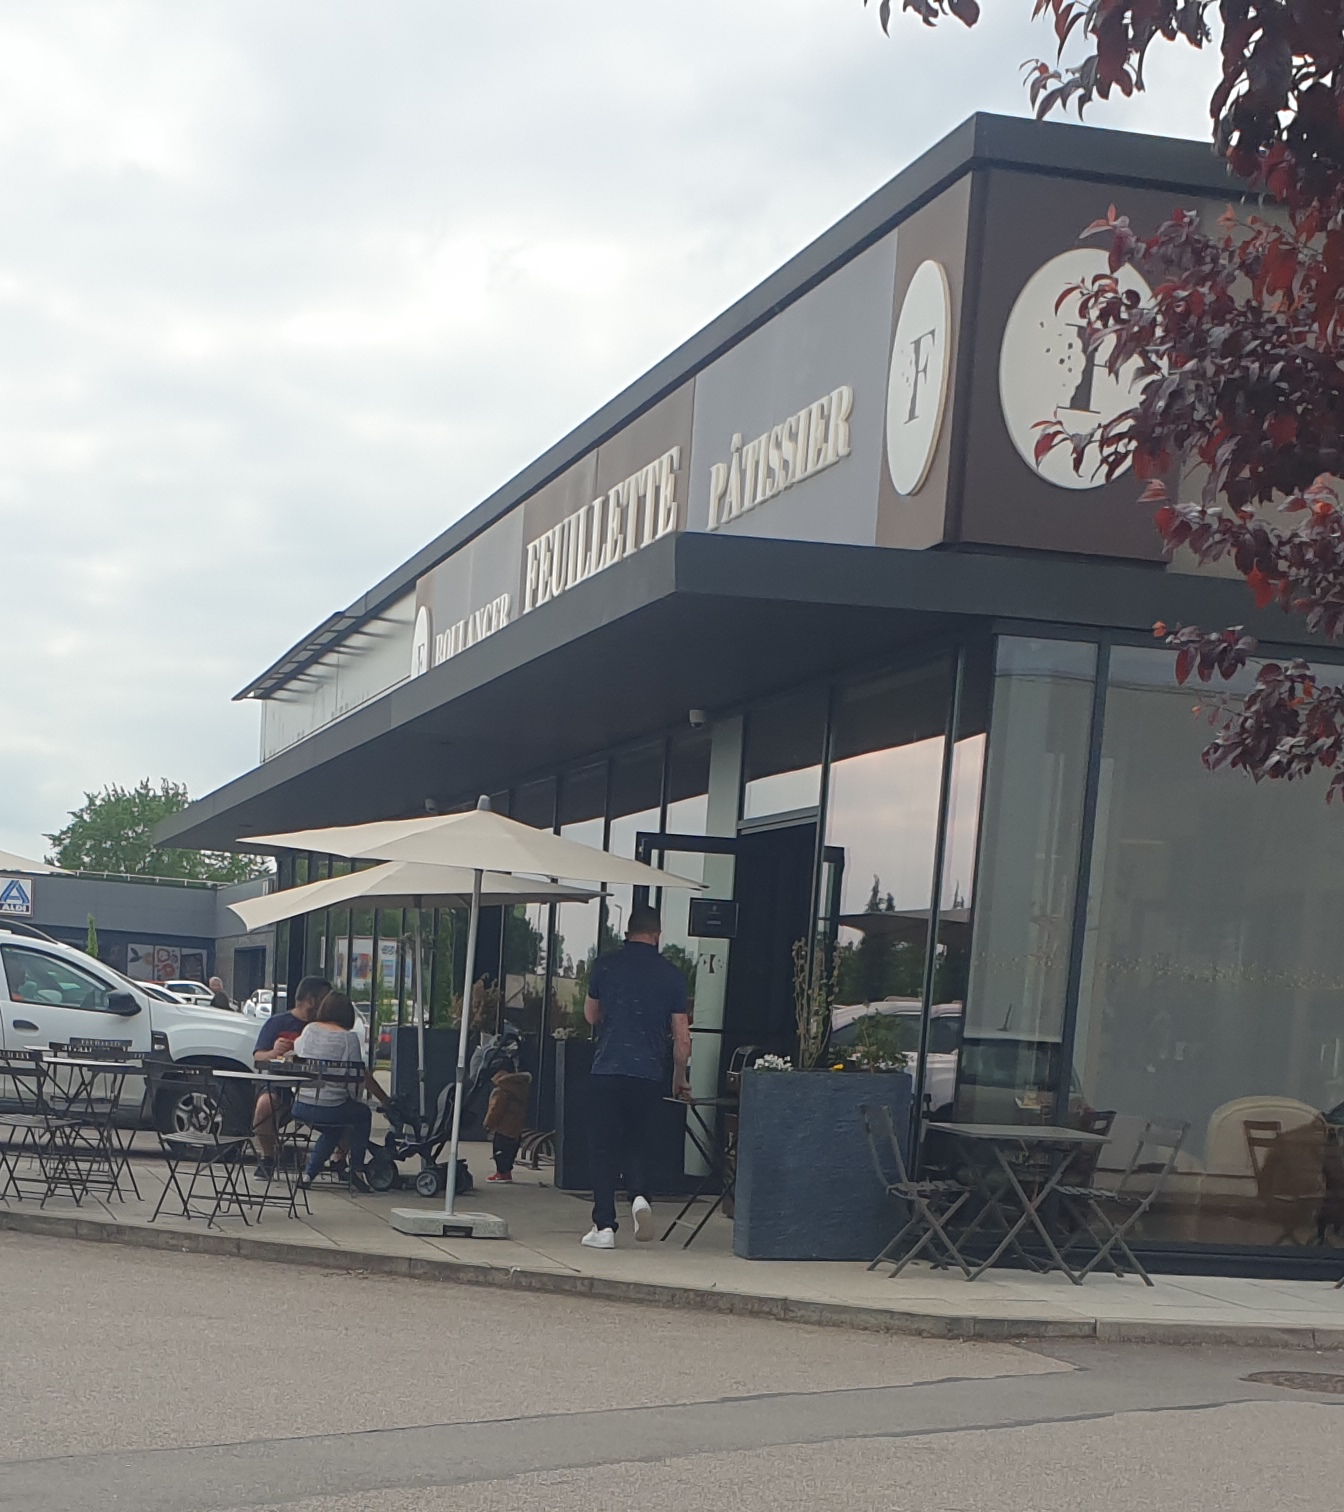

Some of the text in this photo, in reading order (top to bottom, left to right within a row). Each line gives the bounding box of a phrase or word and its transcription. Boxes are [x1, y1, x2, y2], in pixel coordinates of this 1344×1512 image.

[903, 328, 937, 425] F
[706, 385, 854, 532] PÂTISSIER
[523, 445, 681, 614] FEUILLETTE
[1, 903, 27, 912] ALDI
